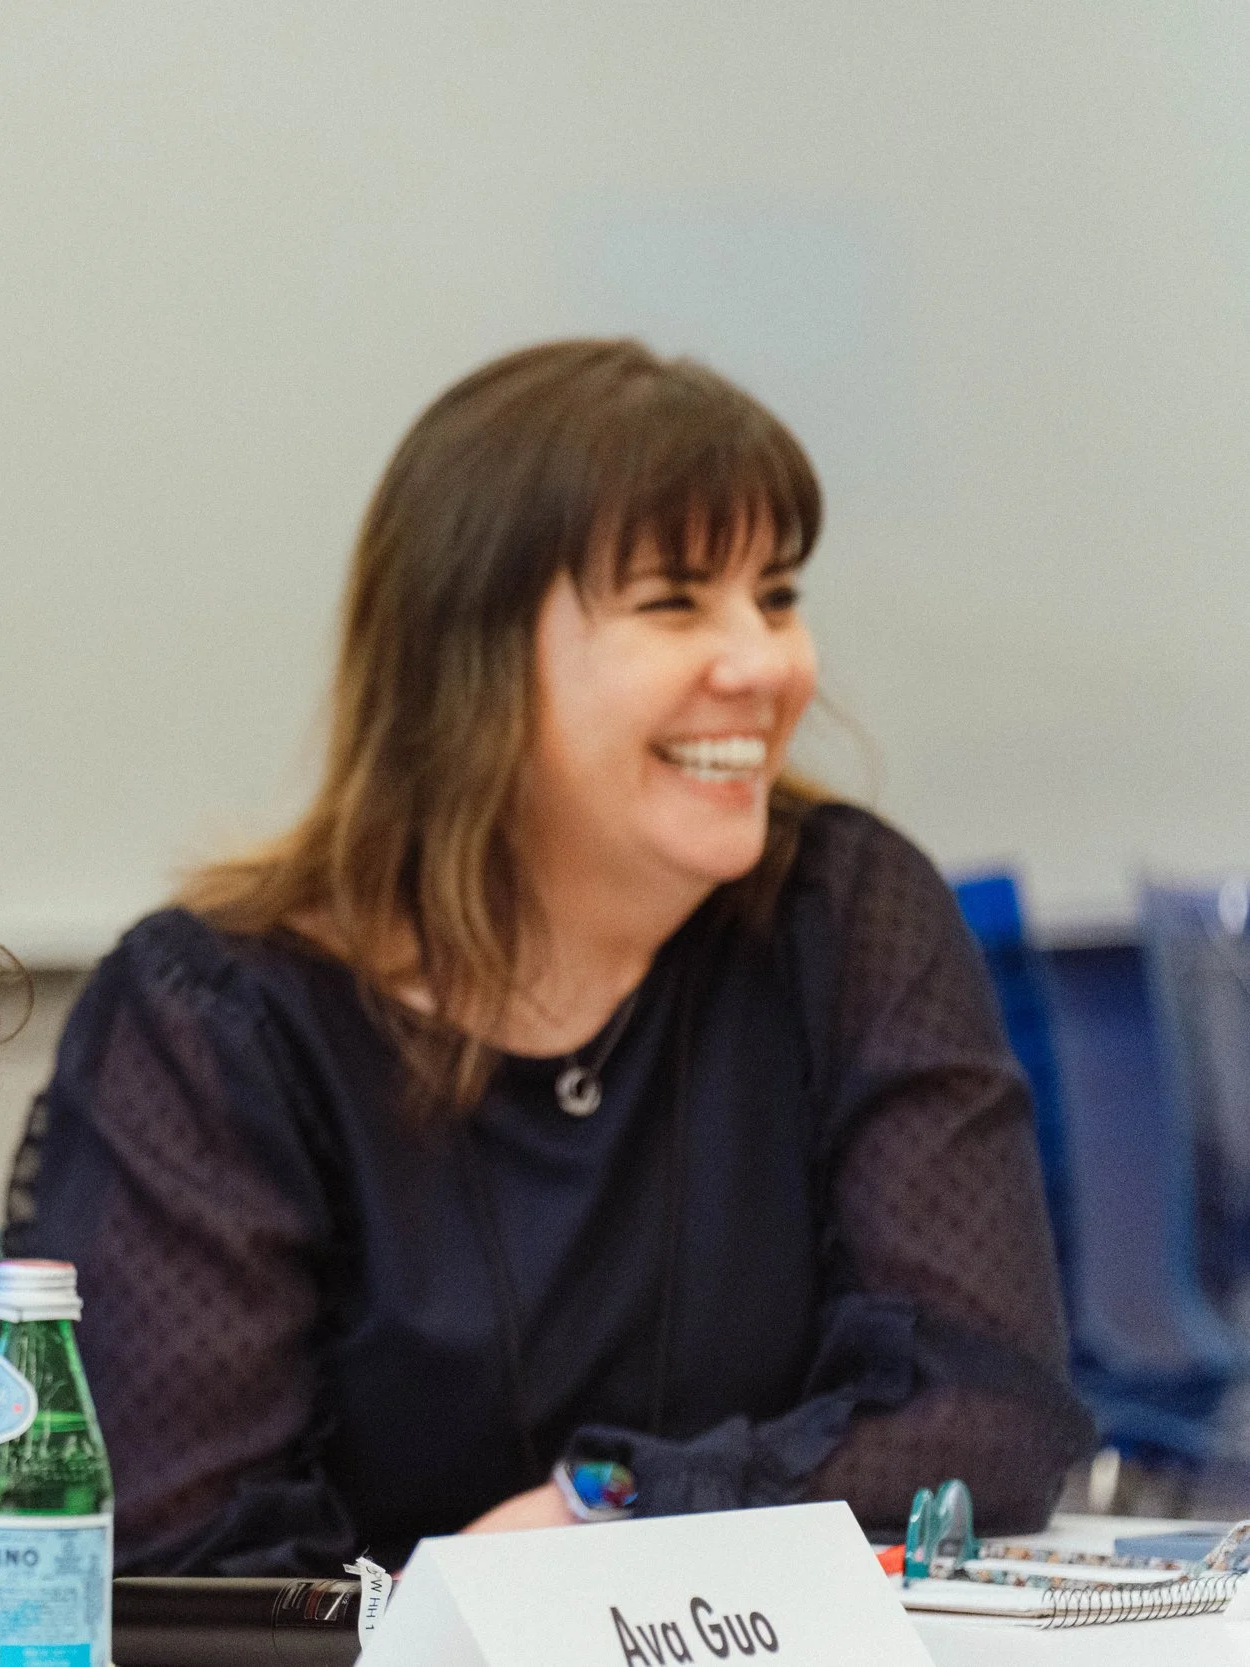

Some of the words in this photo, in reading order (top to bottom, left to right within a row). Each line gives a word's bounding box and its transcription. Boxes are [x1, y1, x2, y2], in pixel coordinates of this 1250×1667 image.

[365, 1597, 381, 1618] HH
[610, 1606, 694, 1667] Ava
[690, 1596, 779, 1659] Guo
